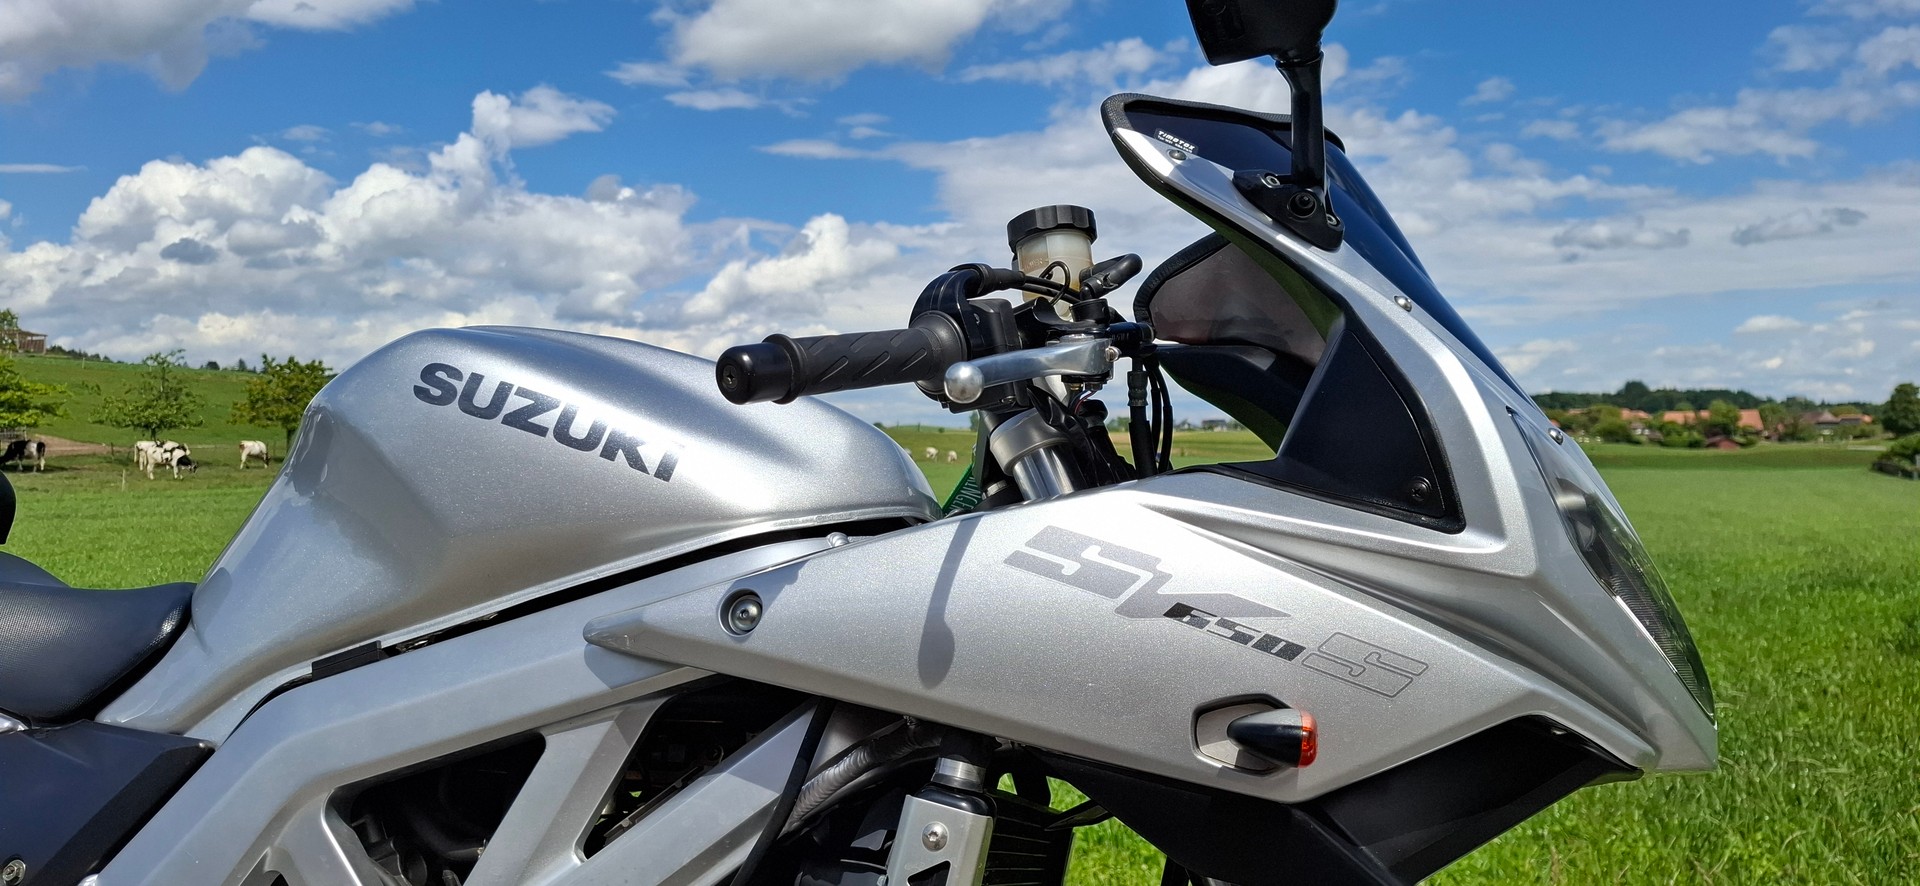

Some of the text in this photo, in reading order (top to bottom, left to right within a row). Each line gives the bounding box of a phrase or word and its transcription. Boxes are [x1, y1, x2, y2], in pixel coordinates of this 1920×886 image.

[413, 362, 685, 482] SUZUKI
[1163, 602, 1307, 662] 650
[1302, 631, 1429, 698] S
